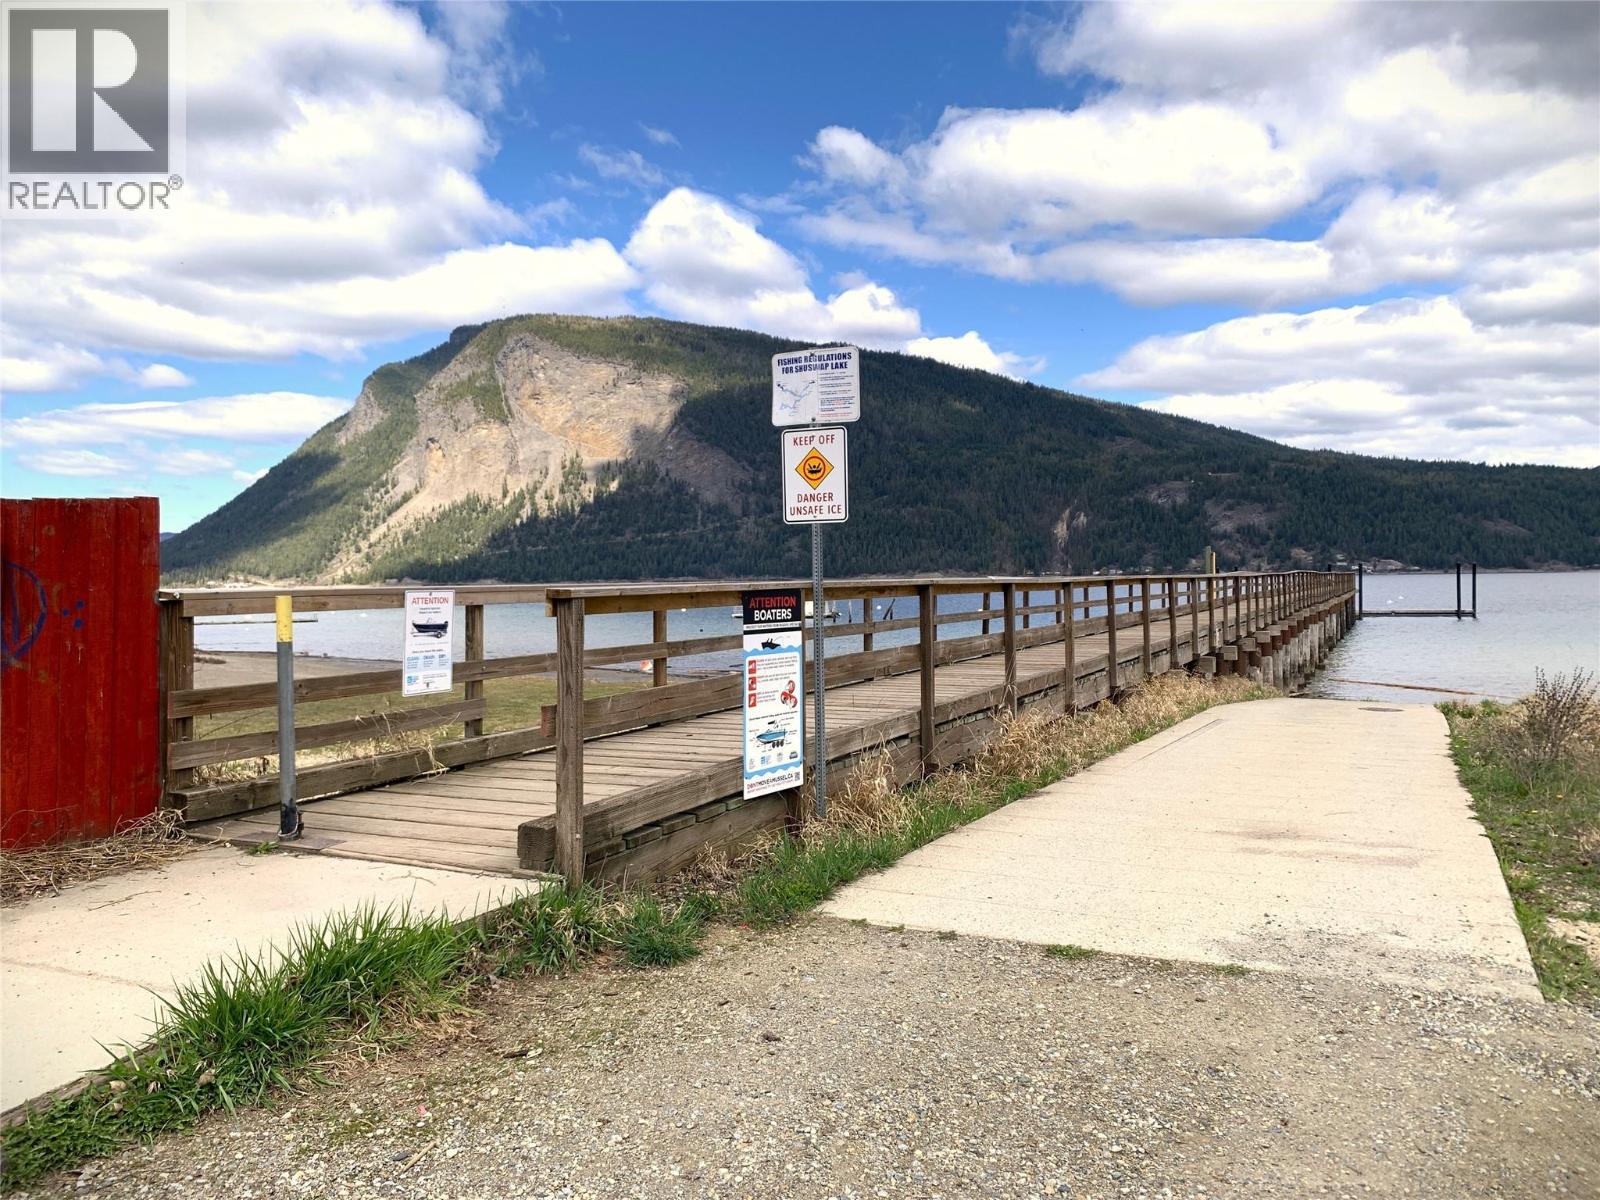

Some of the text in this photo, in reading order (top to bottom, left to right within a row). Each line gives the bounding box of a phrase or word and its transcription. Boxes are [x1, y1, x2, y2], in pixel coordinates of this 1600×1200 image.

[777, 352, 852, 367] FISHING REGULATIONS
[781, 361, 848, 375] FOR SHUSWAP LAKE
[793, 434, 835, 446] KEEP OFF
[797, 492, 834, 503] DANGER
[790, 504, 842, 516] UNSAFE ICE
[412, 596, 449, 605] ATTENTION
[750, 596, 797, 609] ATTENTION
[754, 608, 792, 621] BOATERS
